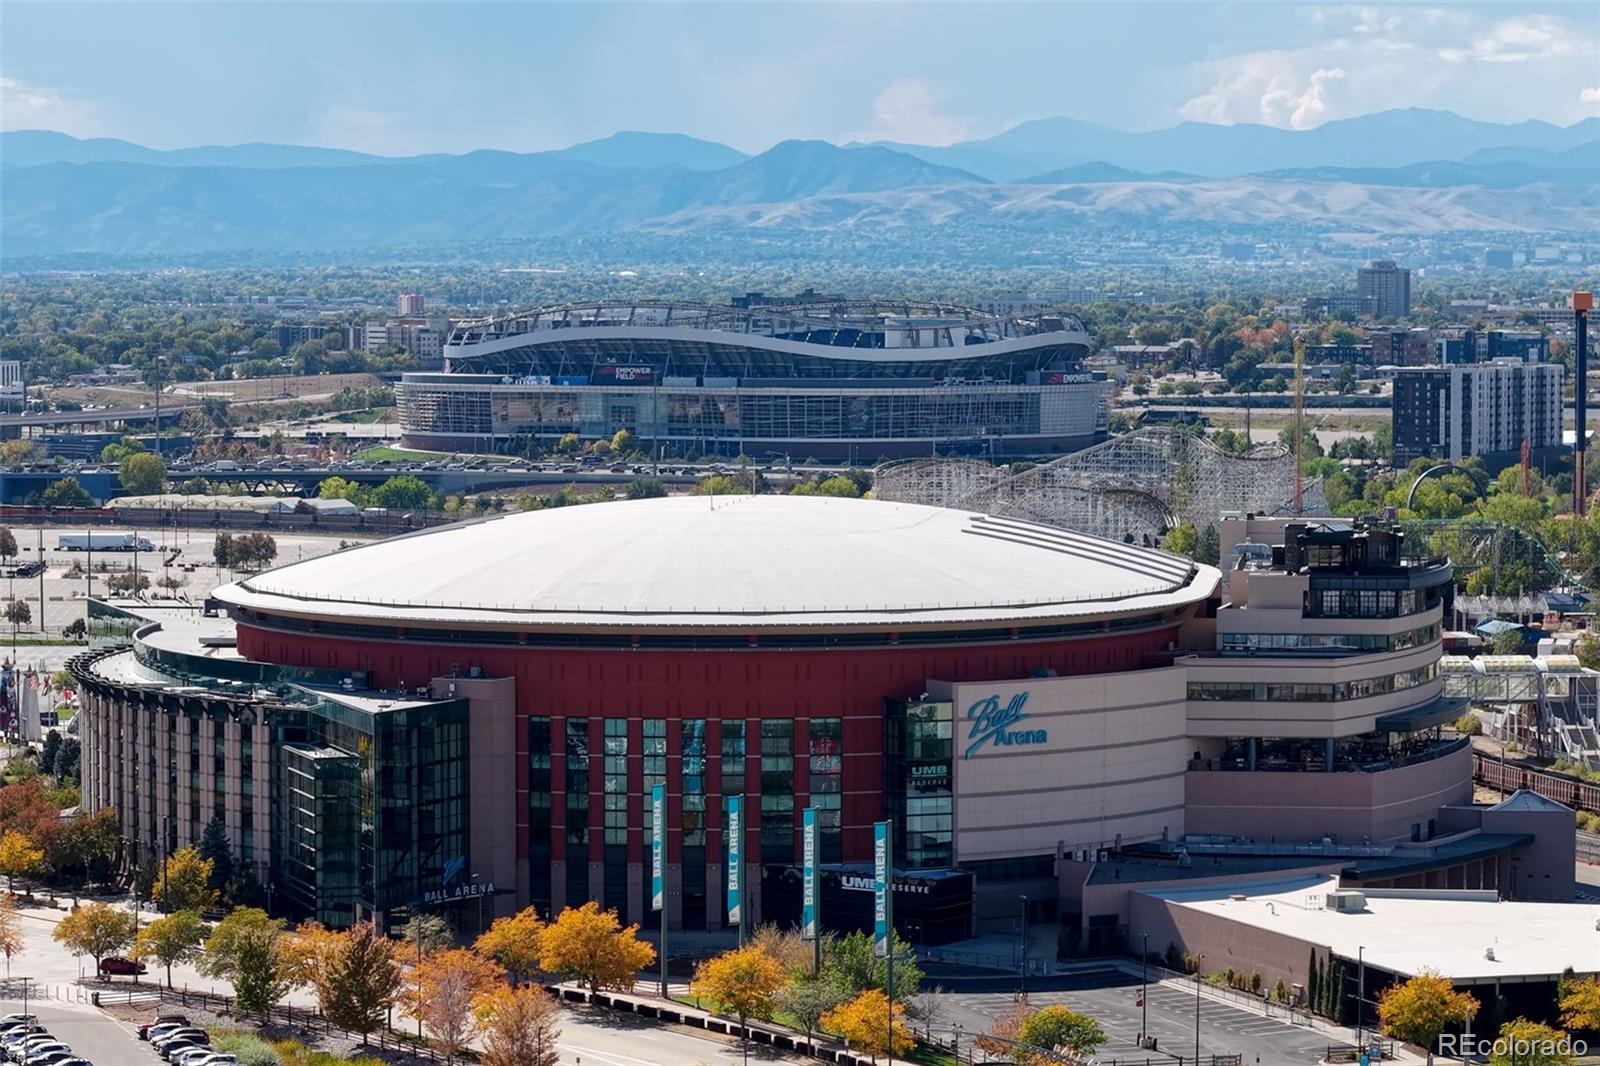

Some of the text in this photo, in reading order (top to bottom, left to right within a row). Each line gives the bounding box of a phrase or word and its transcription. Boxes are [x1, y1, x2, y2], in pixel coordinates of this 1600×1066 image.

[965, 691, 1030, 761] Ball
[994, 728, 1048, 746] Arena
[911, 765, 948, 775] UMB
[653, 800, 661, 877] BALL ARENA
[729, 811, 739, 890] BALL ARENA
[804, 824, 814, 905] BALL ARENA
[425, 883, 494, 901] BALL ARENA
[876, 838, 885, 922] BALL ARENA
[886, 883, 929, 894] ESERVE
